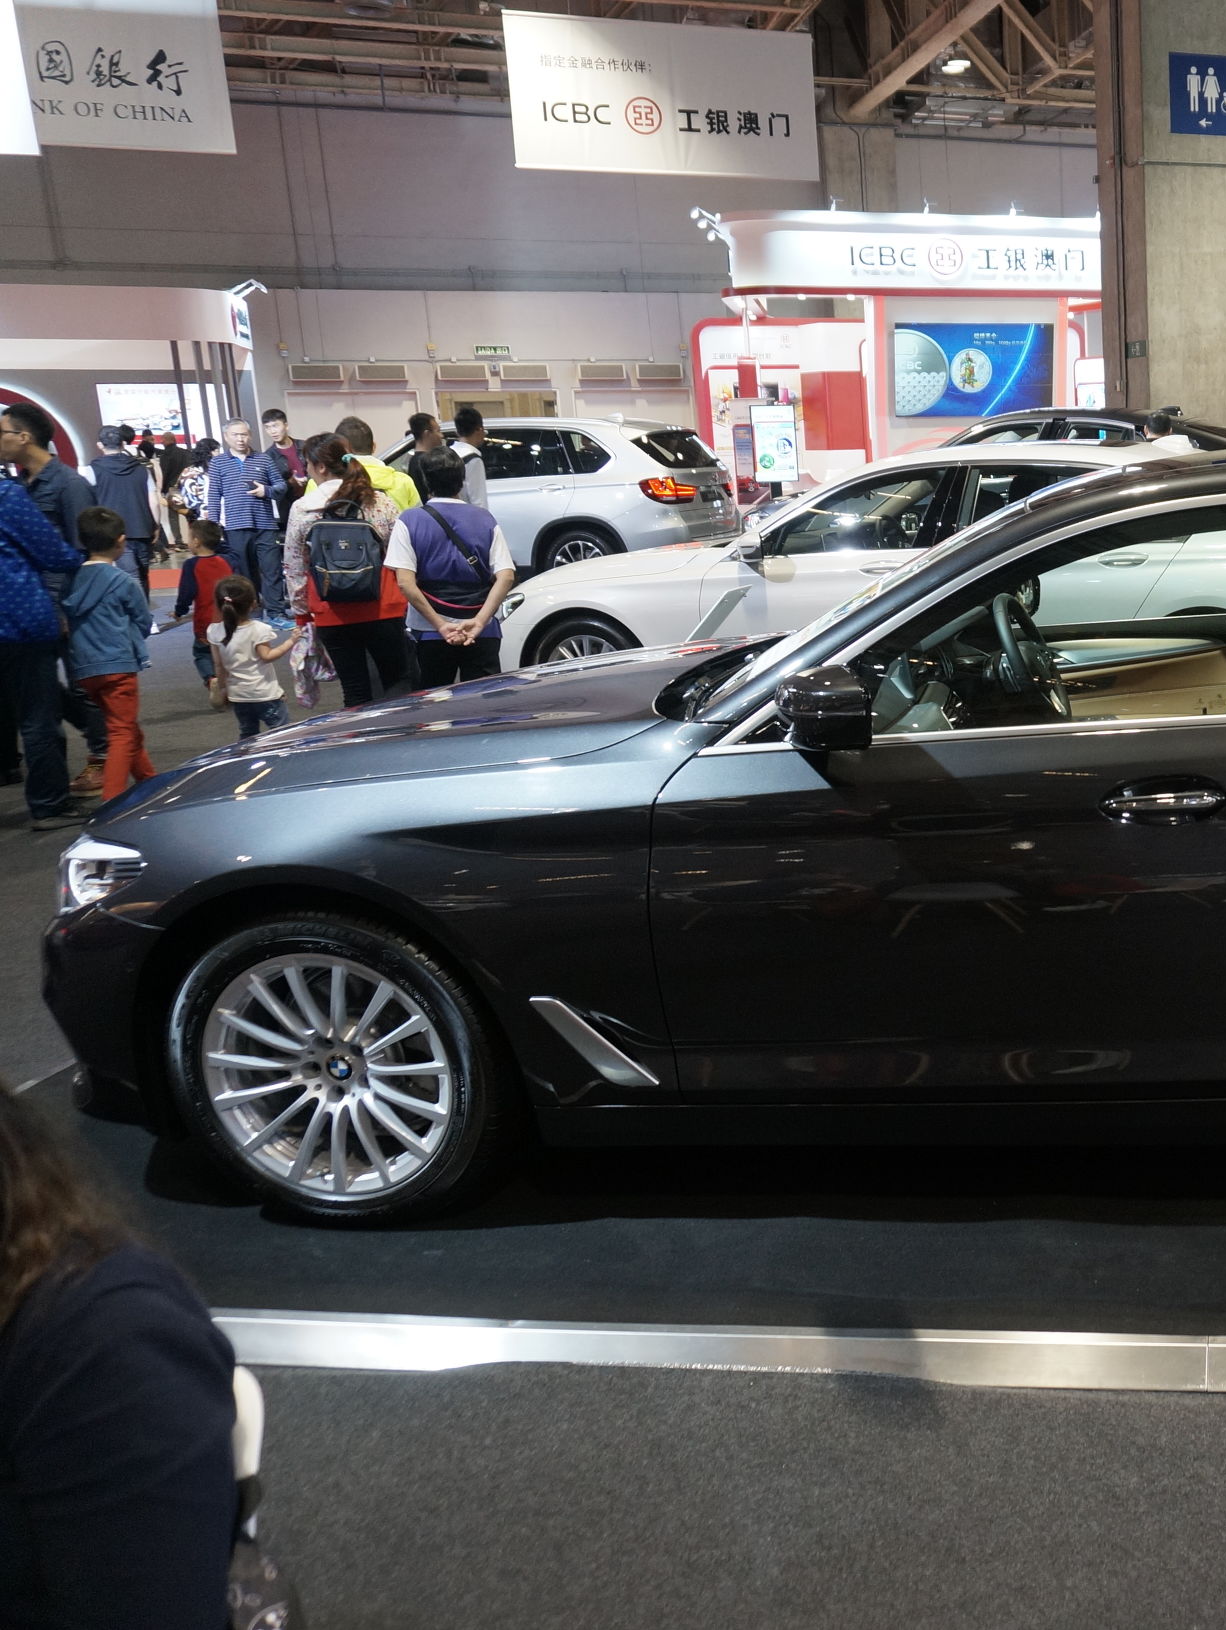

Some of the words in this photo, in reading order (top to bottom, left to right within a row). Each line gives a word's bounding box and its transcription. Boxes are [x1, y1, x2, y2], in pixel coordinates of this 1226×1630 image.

[73, 101, 105, 117] OF
[113, 103, 193, 123] CHINA
[542, 101, 612, 125] ICBC
[677, 108, 791, 138] 工银澳门
[850, 245, 917, 267] ICBC
[977, 247, 1085, 272] 工银澳门
